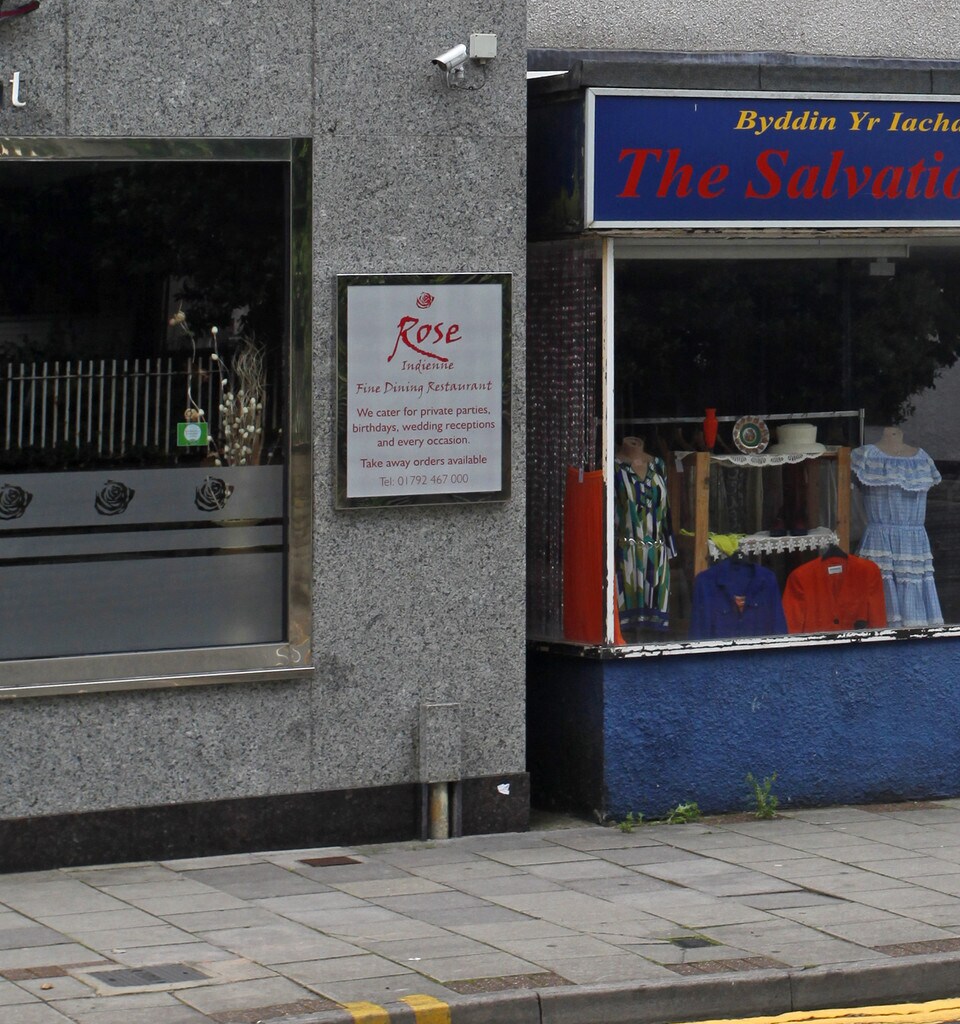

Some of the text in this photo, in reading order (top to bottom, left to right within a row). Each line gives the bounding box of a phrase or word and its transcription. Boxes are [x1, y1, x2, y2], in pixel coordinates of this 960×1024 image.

[734, 110, 836, 136] Byddin
[849, 111, 880, 131] Yr
[616, 148, 730, 200] The
[387, 315, 462, 363] Rose
[401, 359, 454, 374] Indienne
[356, 381, 493, 399] Fine Dining Restaurant
[357, 406, 491, 418] We cater for private parties,
[352, 420, 496, 434] birthdays, wedding receptions
[377, 436, 470, 448] and every occasion.
[360, 455, 487, 469] Take away orders available
[379, 474, 469, 487] Tel: 01792 467 000
